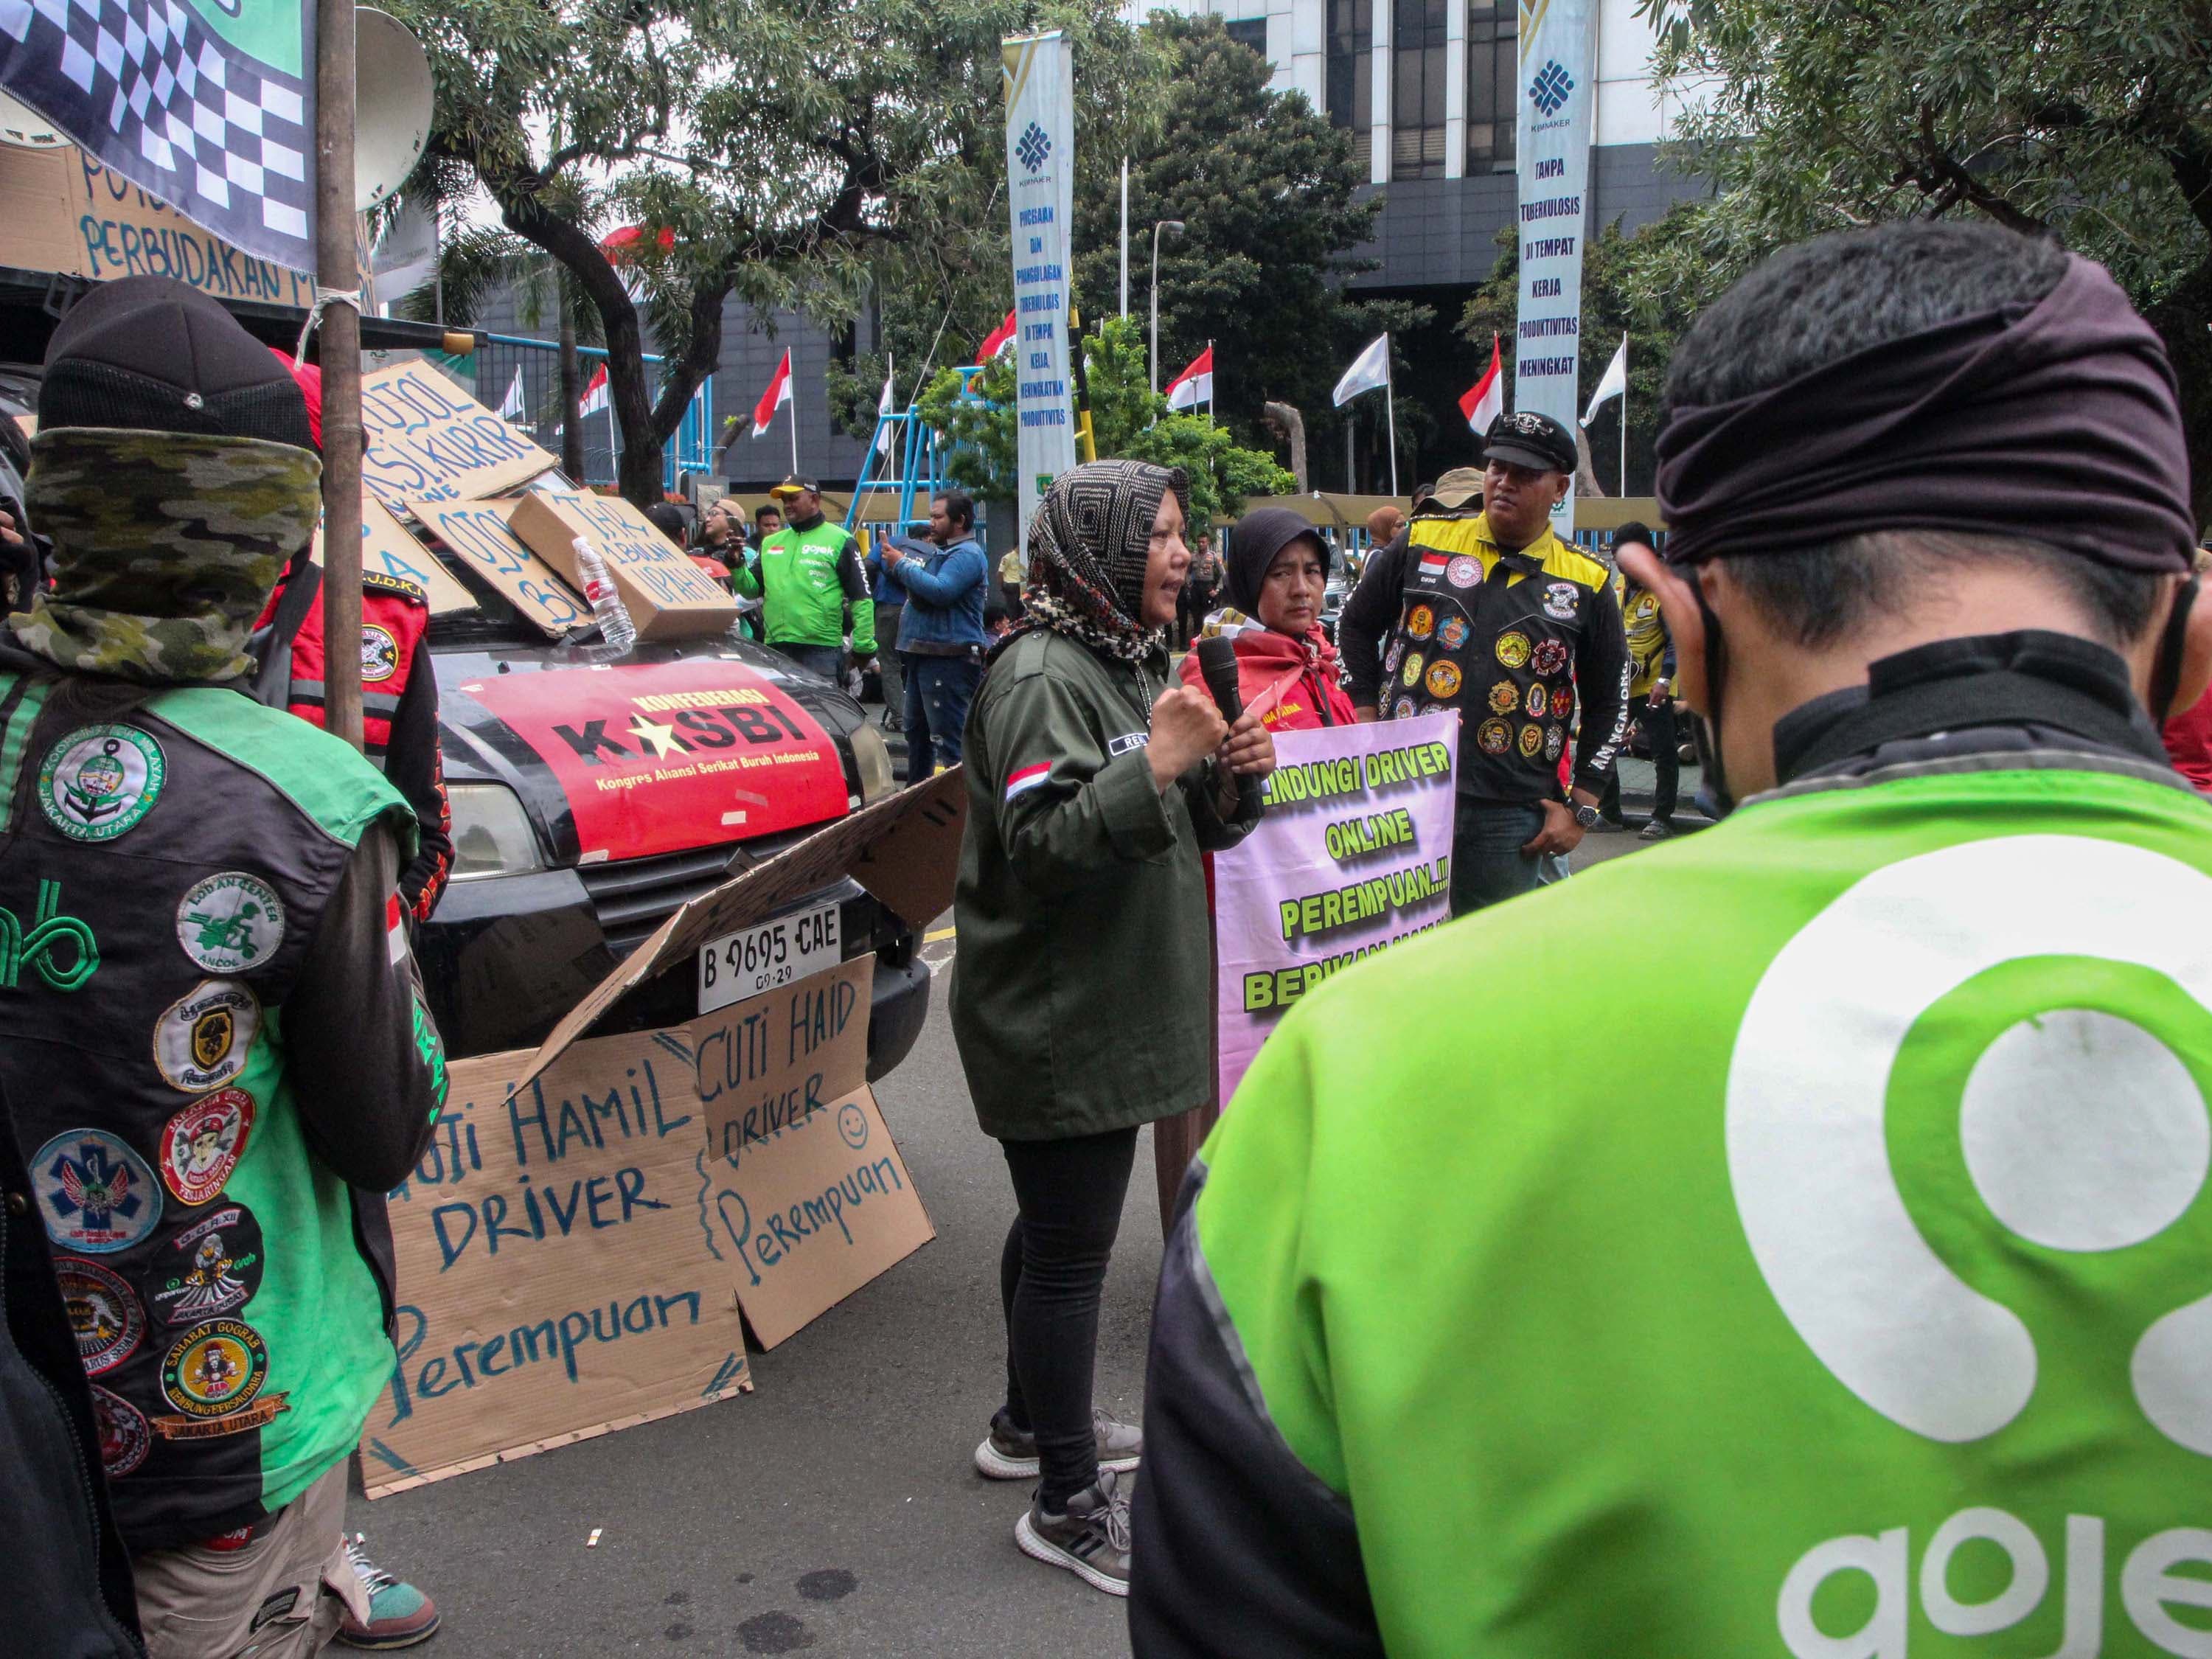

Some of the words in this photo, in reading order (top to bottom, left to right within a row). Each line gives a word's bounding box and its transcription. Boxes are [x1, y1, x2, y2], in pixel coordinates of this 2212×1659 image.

[1535, 159, 1564, 180] TANPA
[1520, 197, 1580, 221] TUBERKULOSIS
[80, 215, 280, 299] PERBUDAKAN
[1526, 242, 1533, 260] DI
[1534, 237, 1575, 259] TEMPAT
[1532, 278, 1561, 298] KERJA
[1519, 317, 1577, 339] PRODUKTIVITAS
[1520, 356, 1574, 378] MENINGKAT
[552, 495, 649, 540] THR
[631, 689, 770, 712] KONFEDERASI
[596, 772, 653, 791] Kongres
[700, 759, 740, 774] Serikat
[742, 755, 773, 768] Buruh
[773, 750, 819, 765] Indonesia
[1366, 740, 1451, 788] DRIVER
[96, 808, 142, 837] UTARA
[1325, 807, 1413, 860] ONLINE
[705, 948, 717, 988] B
[728, 925, 787, 978] 9695
[797, 909, 837, 955] CAE
[233, 1252, 256, 1270] Grab
[167, 1323, 212, 1367] SAHABAT
[218, 1322, 260, 1349] GOGRAB
[388, 1290, 700, 1429] Perempuan
[1777, 1506, 2212, 1659] goje
